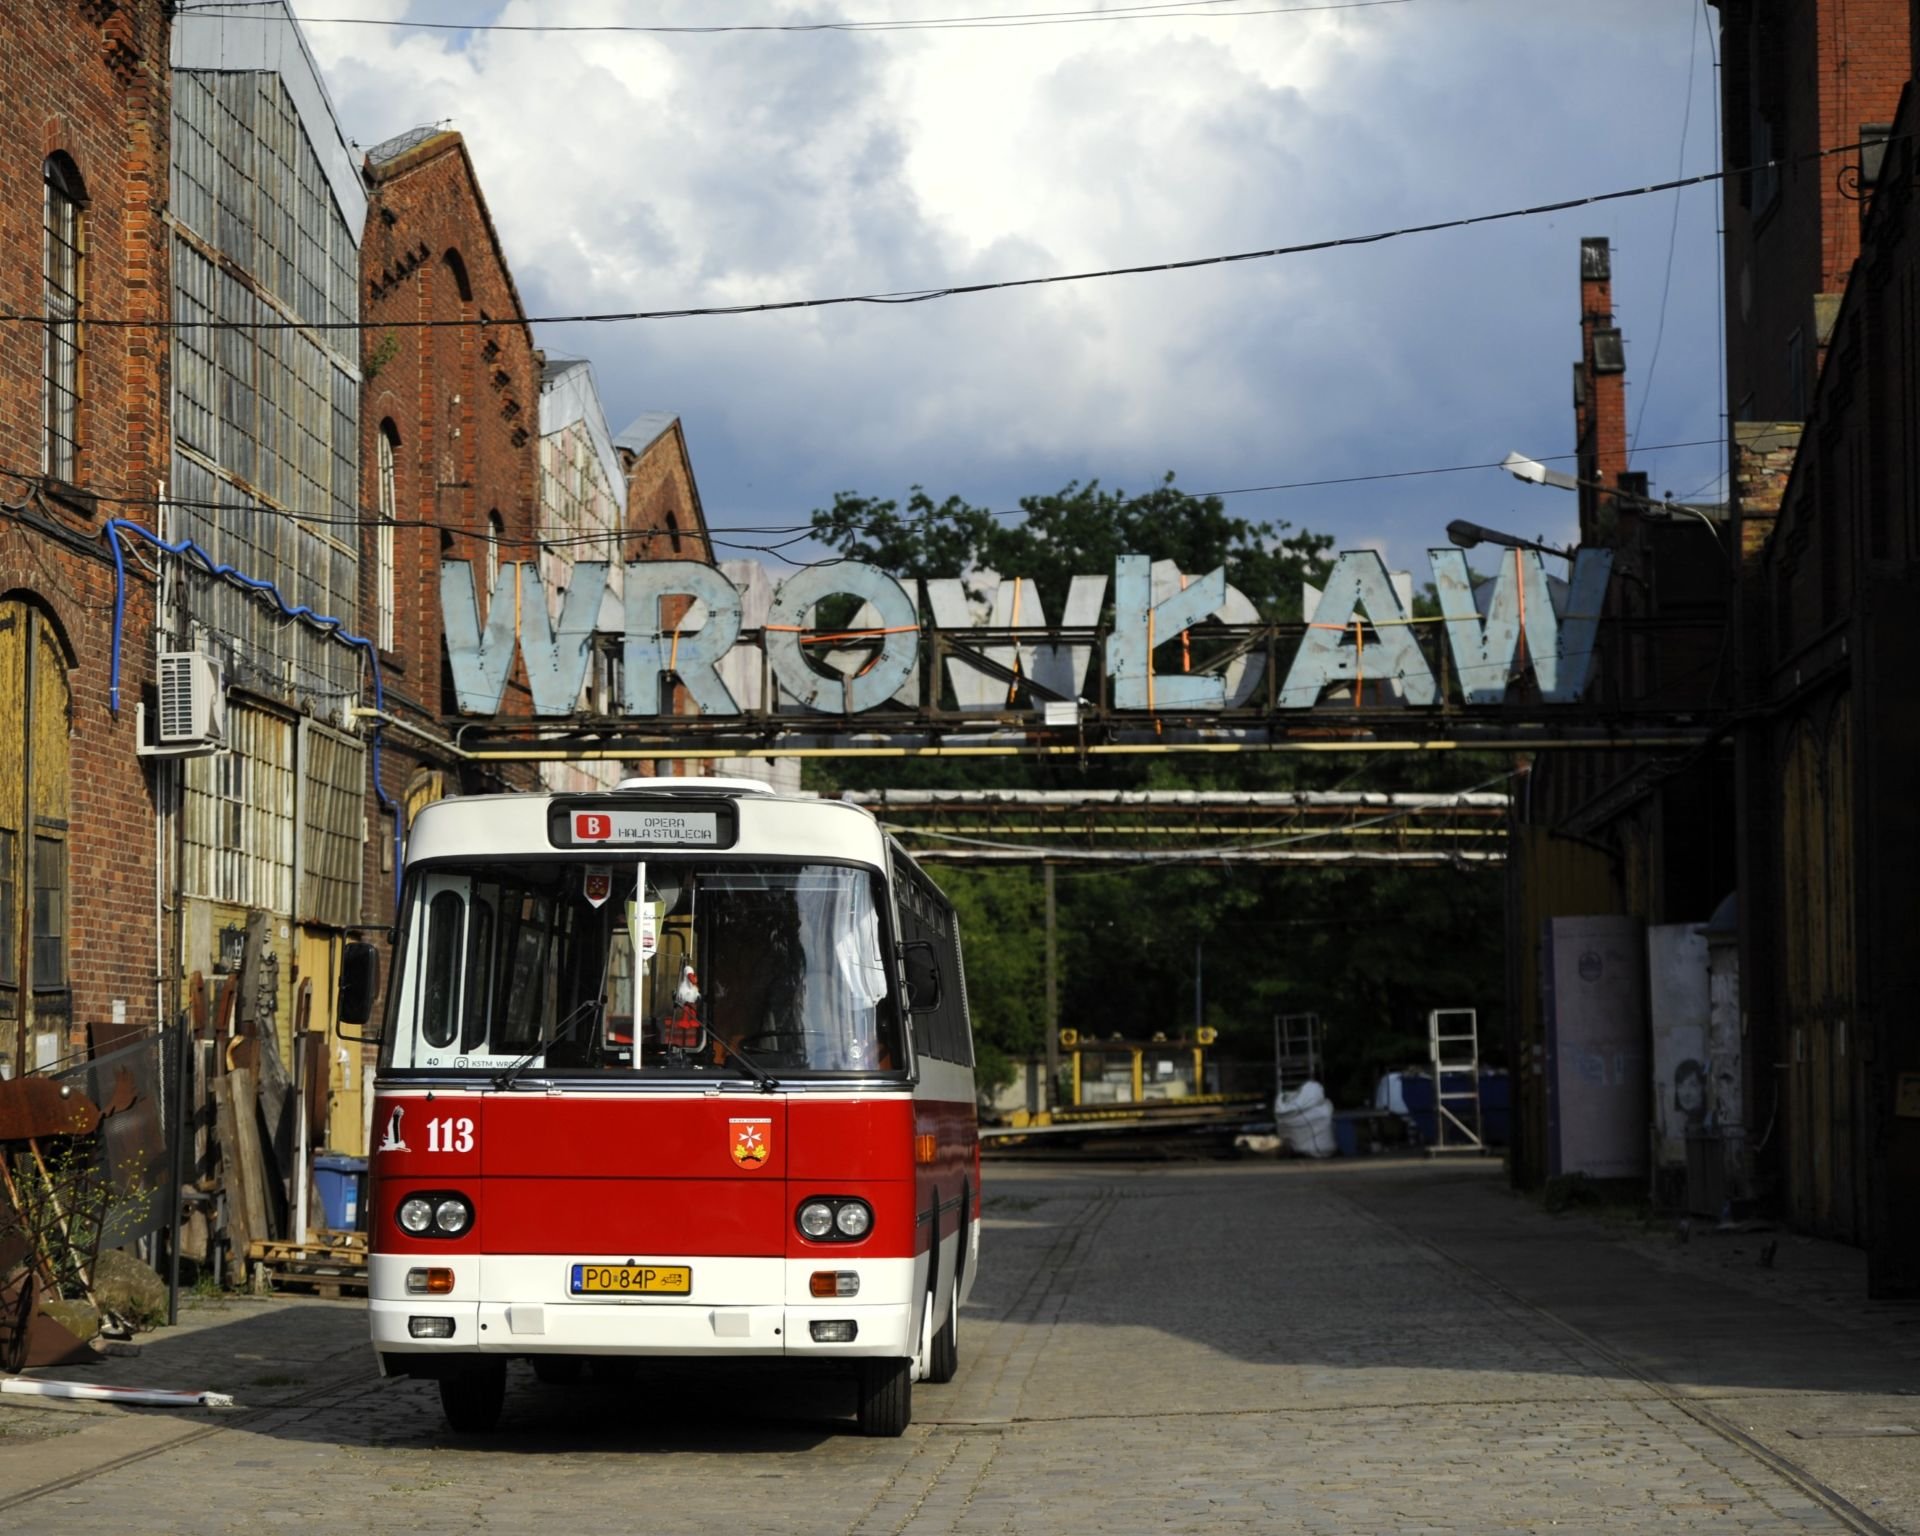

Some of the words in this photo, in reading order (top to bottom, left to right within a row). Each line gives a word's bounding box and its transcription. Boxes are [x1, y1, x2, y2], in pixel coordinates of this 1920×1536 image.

[587, 817, 601, 835] B
[644, 817, 685, 828] OPERA
[618, 828, 650, 839] HALA
[653, 828, 712, 840] STULECIA
[426, 1057, 439, 1066] 40
[426, 1117, 474, 1153] 113
[586, 1268, 612, 1289] PO
[619, 1269, 657, 1289] 84P
